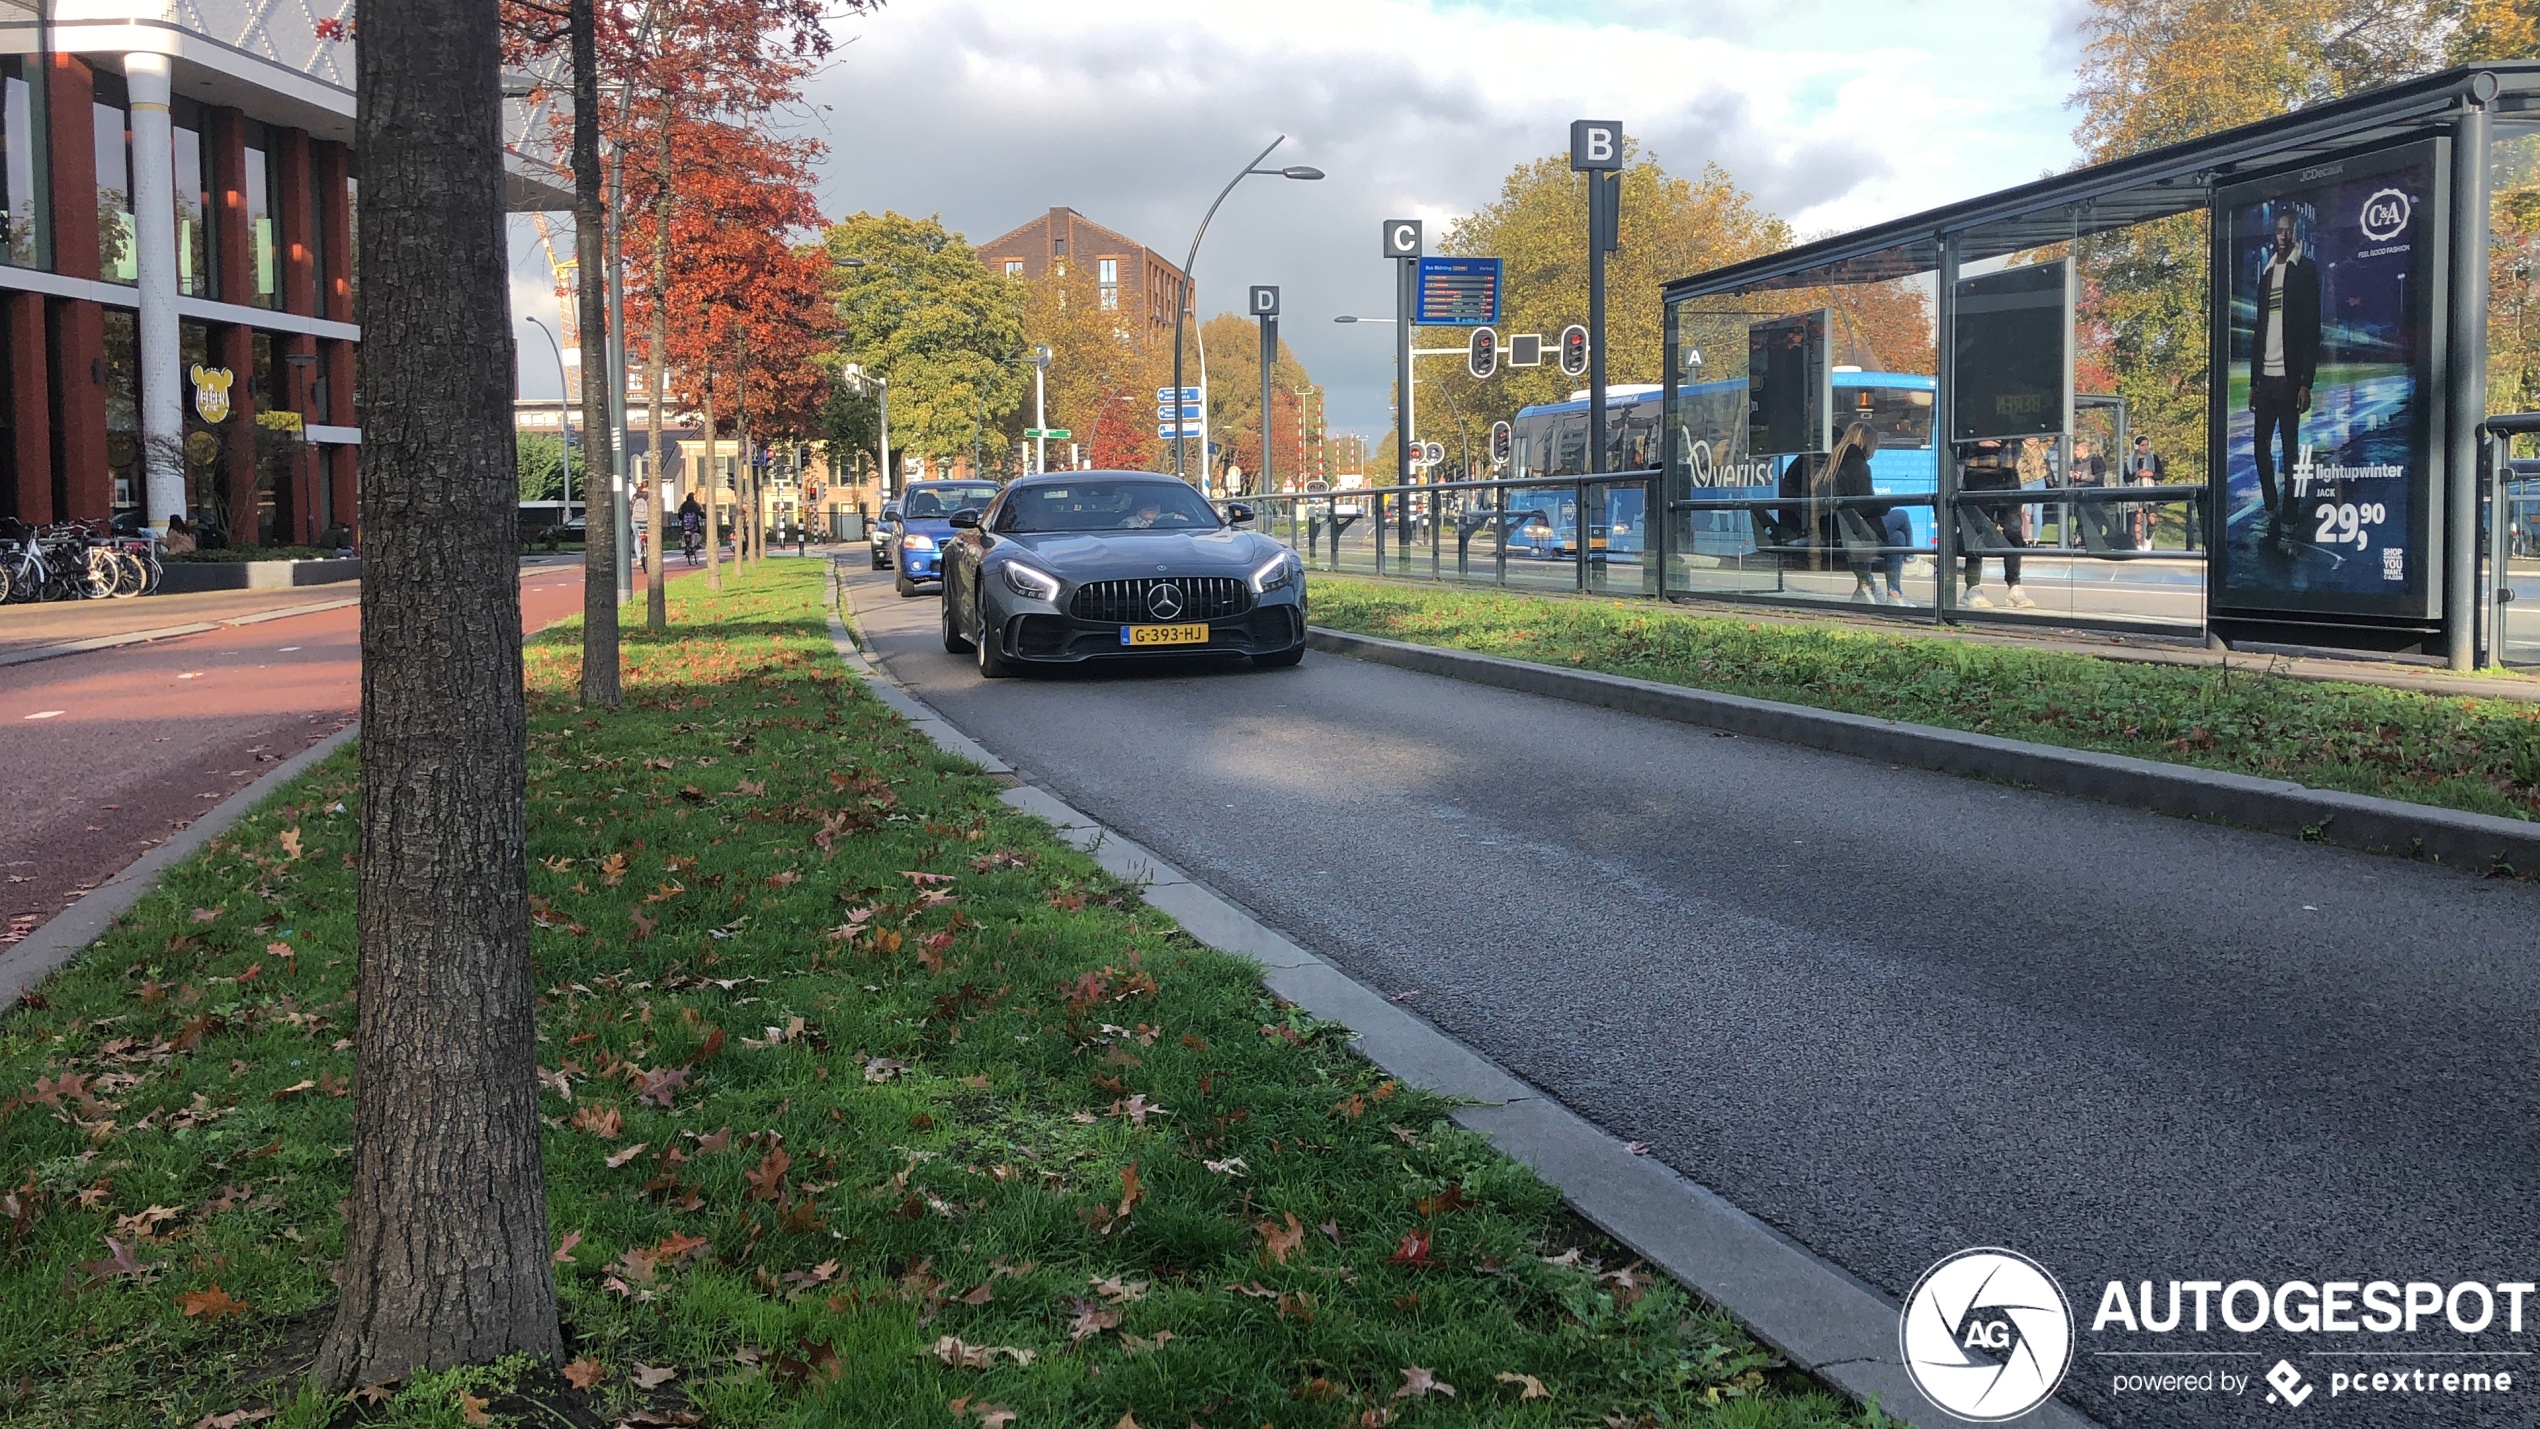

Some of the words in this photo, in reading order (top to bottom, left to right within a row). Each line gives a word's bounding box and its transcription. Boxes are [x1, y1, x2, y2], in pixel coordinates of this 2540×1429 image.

[1587, 128, 1614, 161] B
[2300, 164, 2344, 182] JCDecaux
[2369, 201, 2402, 227] C&A
[1393, 225, 1416, 251] C
[2358, 251, 2370, 259] FEEL
[2370, 248, 2386, 257] GOOD
[2387, 244, 2411, 255] FASHION
[1257, 291, 1274, 310] D
[1688, 349, 1703, 365] A
[1861, 392, 1868, 405] 1
[2316, 488, 2336, 498] JACK
[2383, 547, 2403, 556] SHOP
[2383, 559, 2403, 569] YOU
[1135, 627, 1201, 642] G-393-HJ
